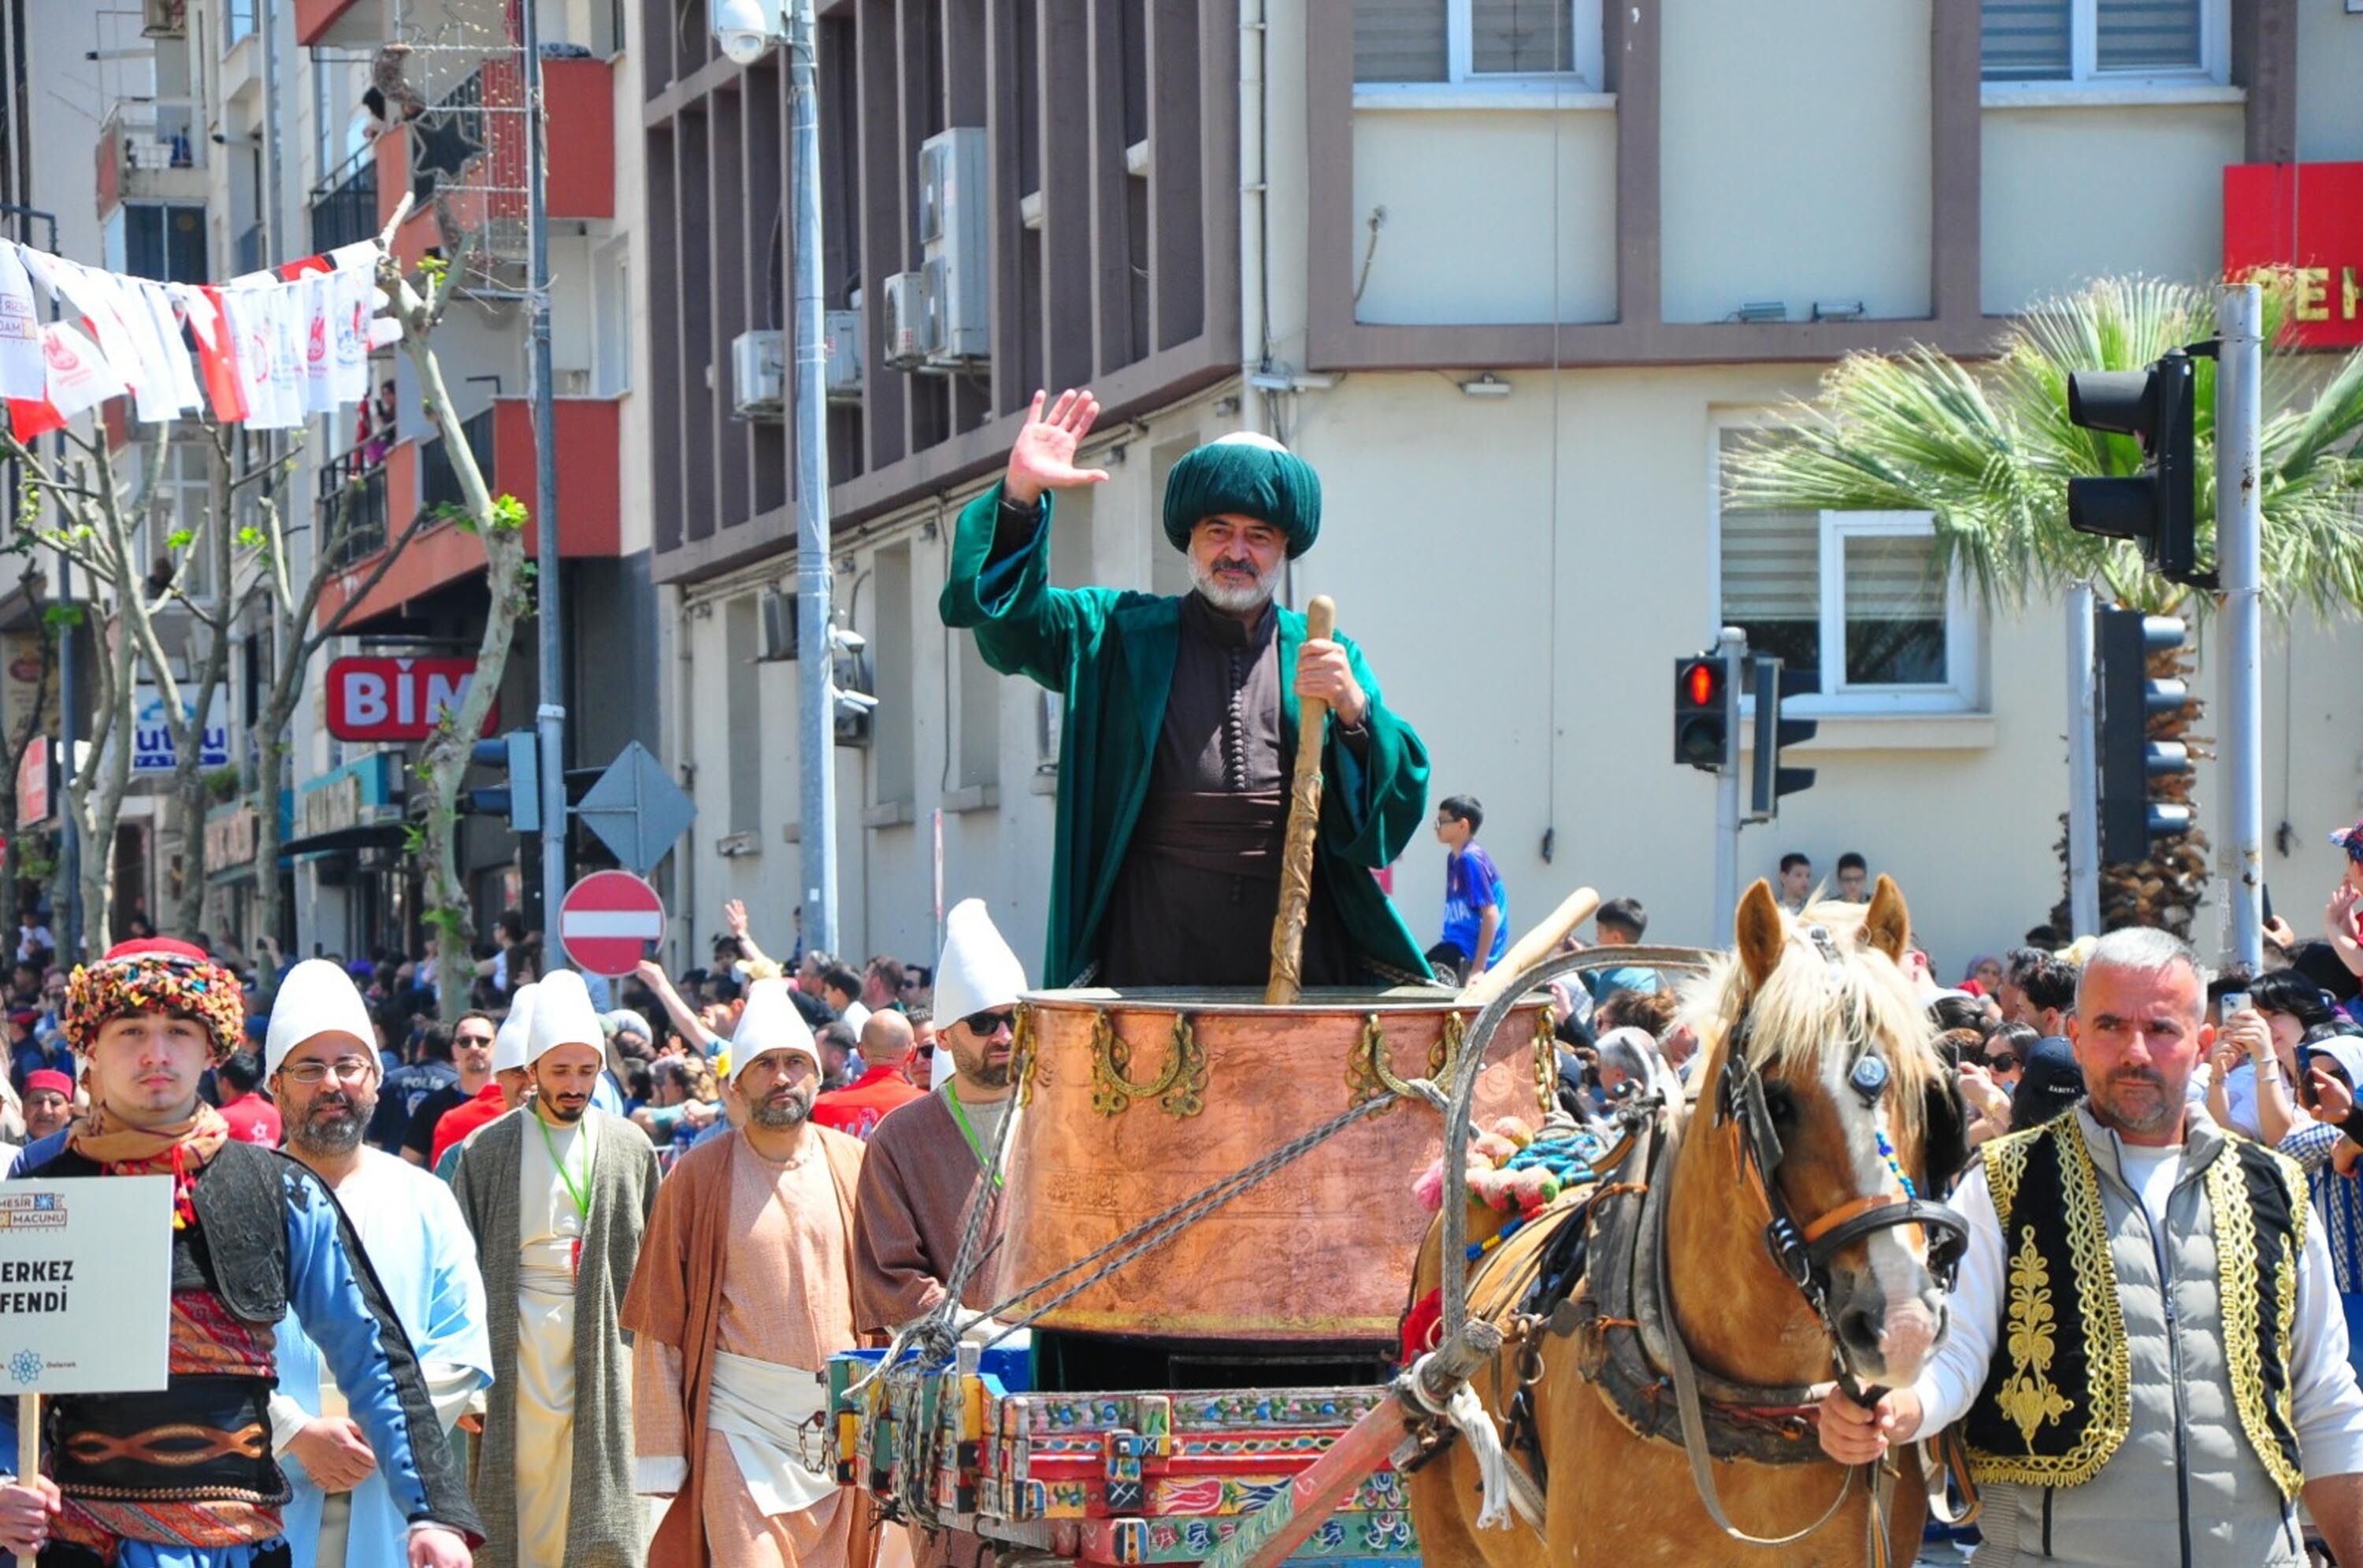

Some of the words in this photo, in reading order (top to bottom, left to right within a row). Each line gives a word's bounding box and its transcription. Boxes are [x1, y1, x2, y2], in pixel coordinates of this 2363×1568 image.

[343, 658, 475, 725] BİM
[126, 725, 224, 751] utu
[13, 1214, 65, 1224] MACUNU
[2, 1260, 74, 1283] ERKEZ
[0, 1284, 68, 1314] FENDİ
